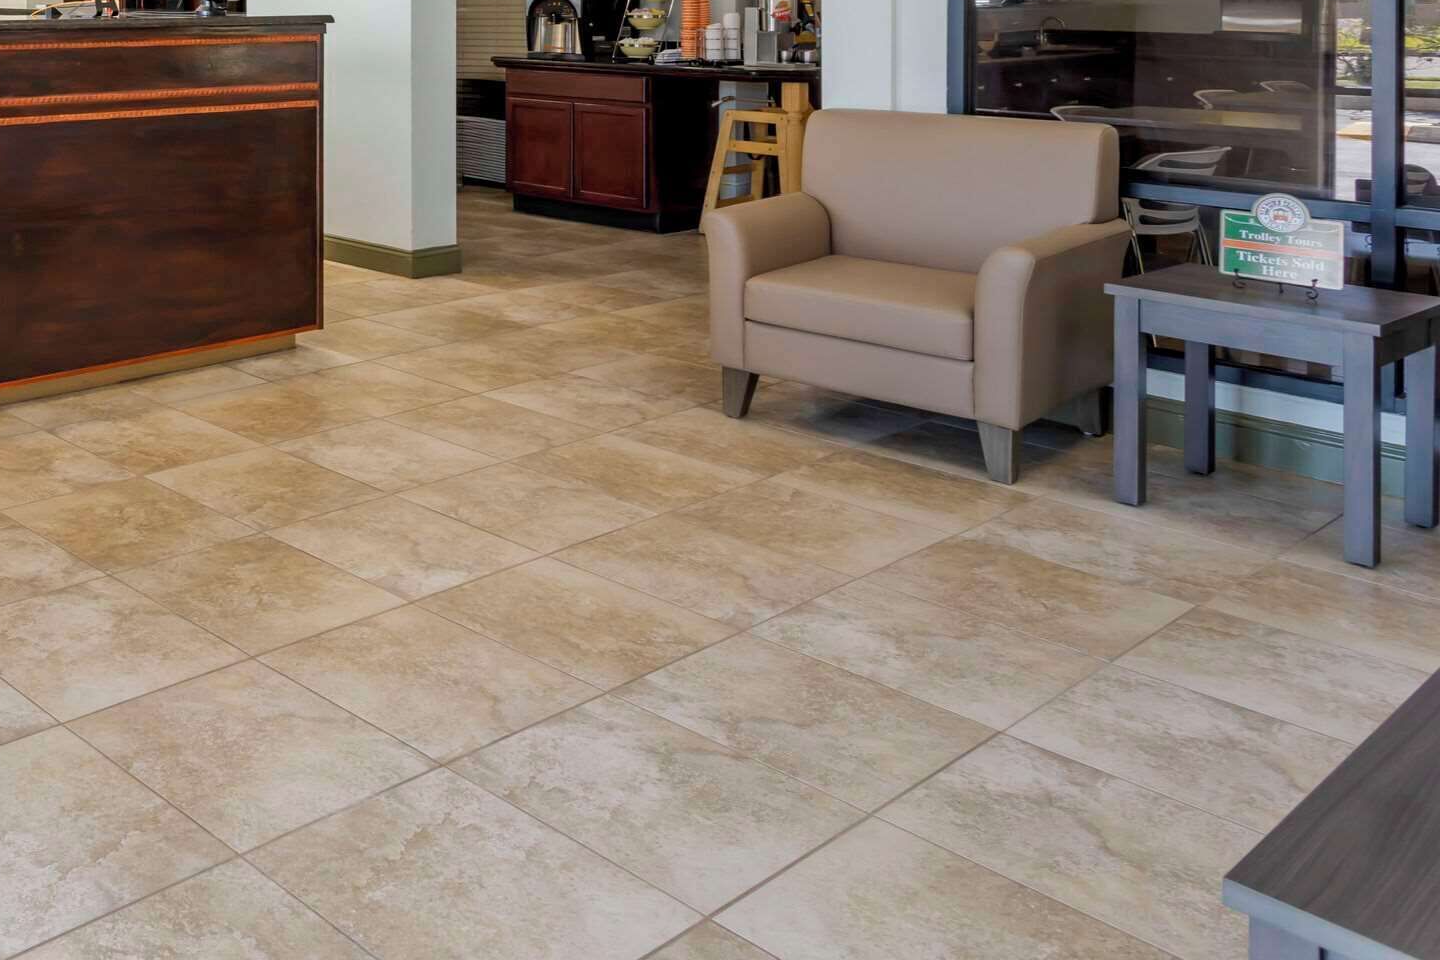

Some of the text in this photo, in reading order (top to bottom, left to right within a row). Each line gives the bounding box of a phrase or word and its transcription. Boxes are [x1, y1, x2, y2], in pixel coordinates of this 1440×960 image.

[1239, 229, 1323, 248] Trolley Tours
[1236, 250, 1325, 271] Tickets Sold
[1262, 265, 1298, 279] Here
